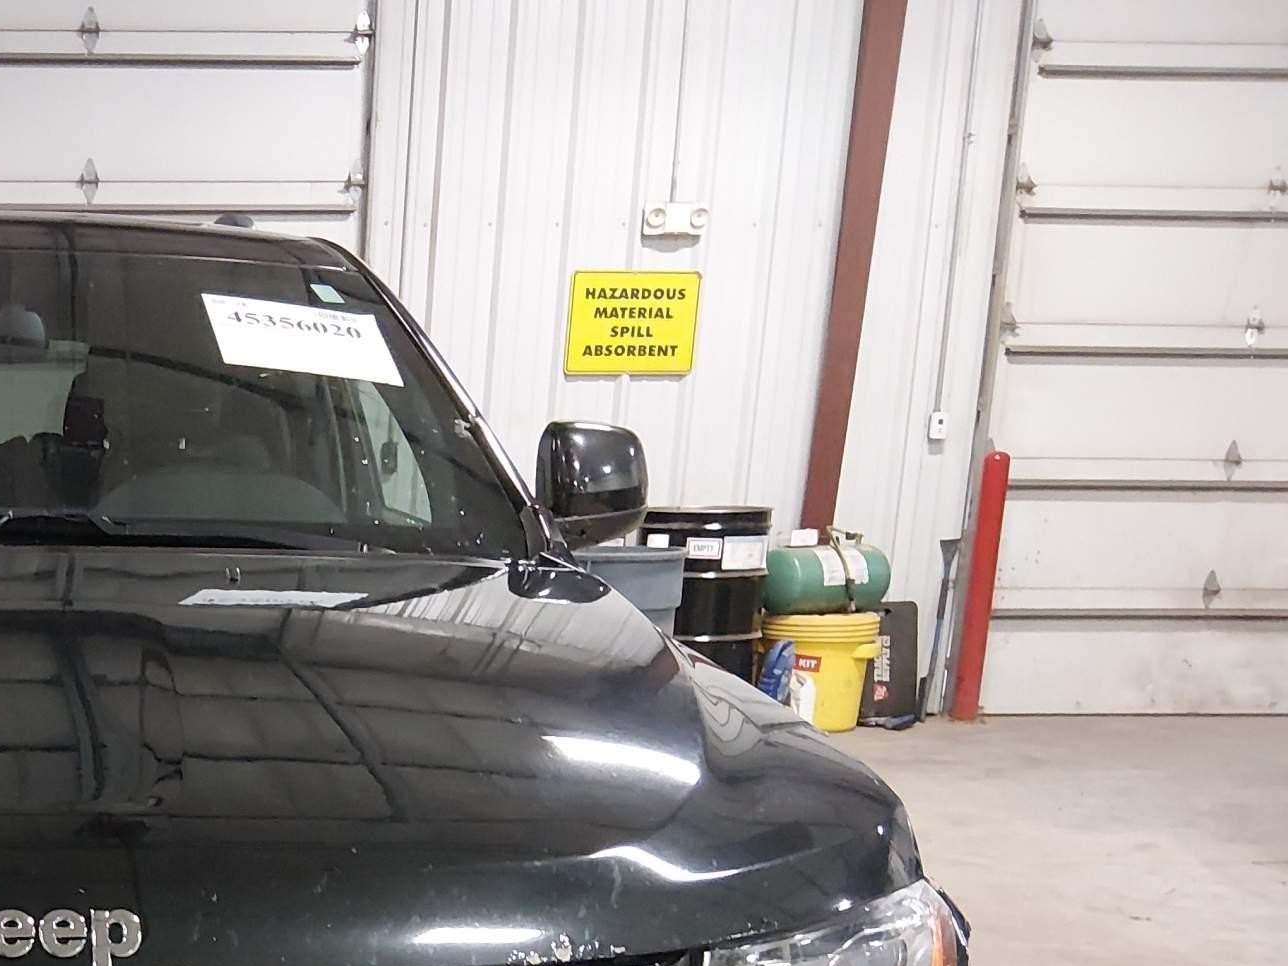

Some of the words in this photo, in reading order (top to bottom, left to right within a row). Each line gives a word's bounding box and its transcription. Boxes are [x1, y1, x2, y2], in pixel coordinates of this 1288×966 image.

[585, 287, 687, 300] HAZARDOUS
[593, 307, 673, 320] MATERIAL
[227, 311, 362, 339] 45356020
[609, 325, 654, 338] SPILL
[582, 344, 679, 357] ABSORBENT
[798, 658, 818, 668] KIT
